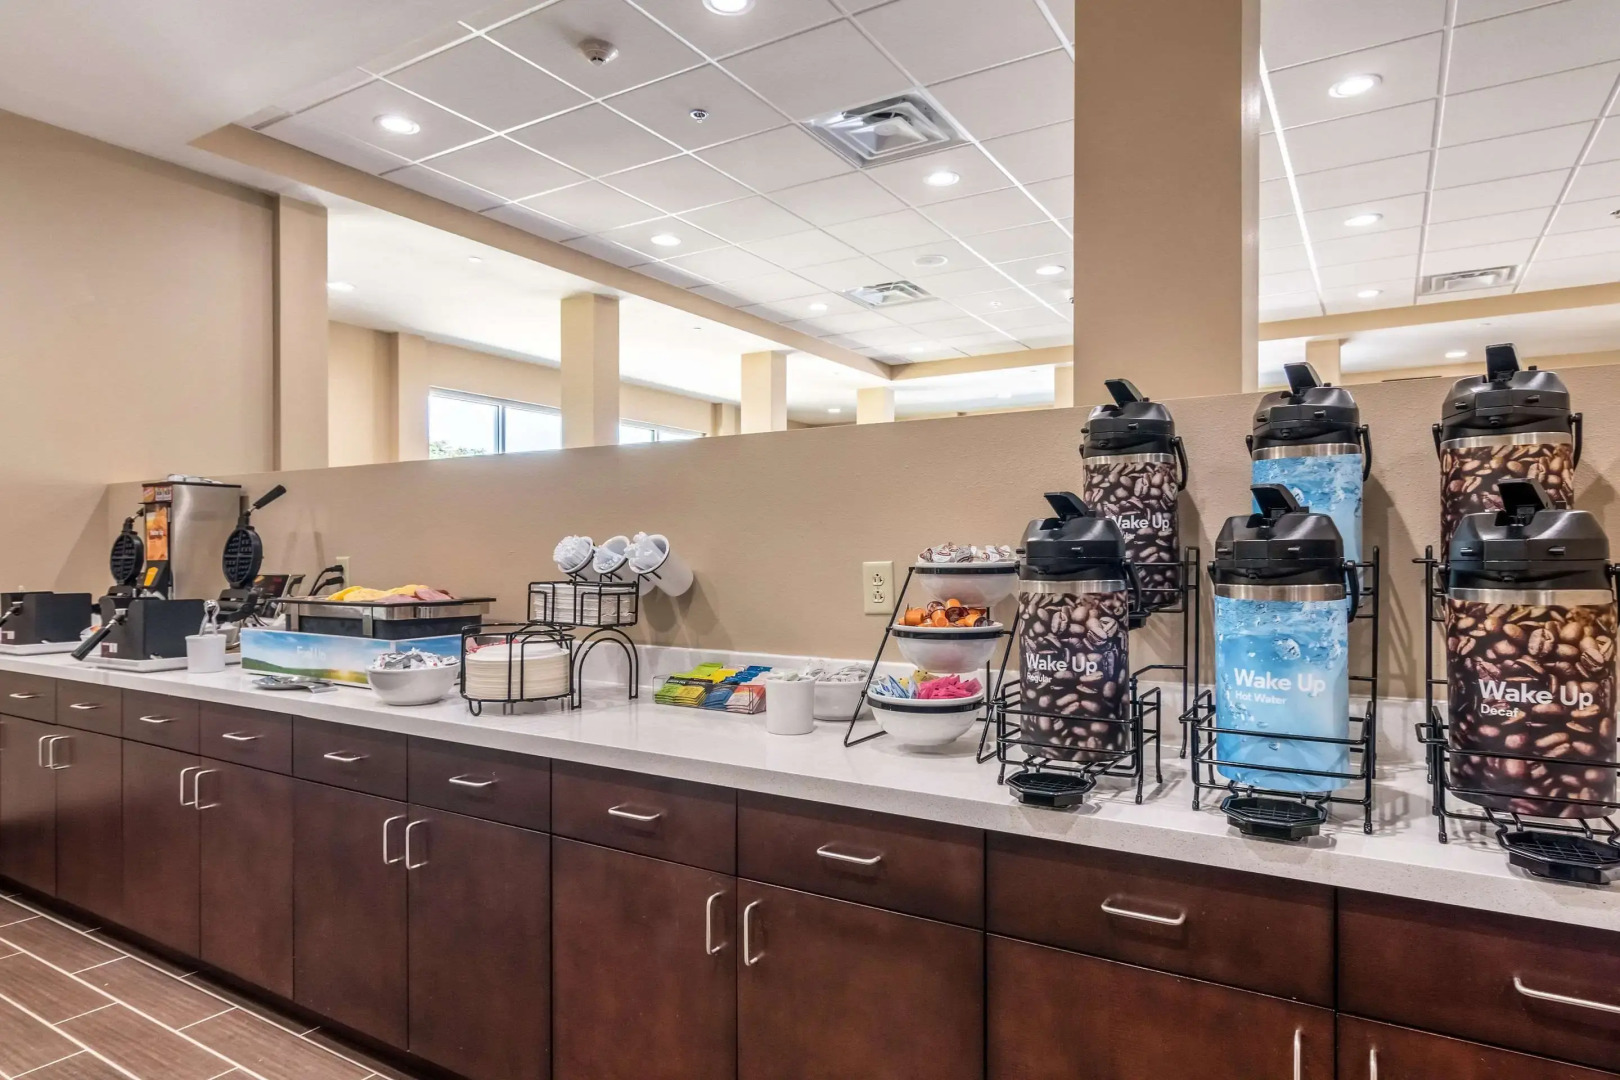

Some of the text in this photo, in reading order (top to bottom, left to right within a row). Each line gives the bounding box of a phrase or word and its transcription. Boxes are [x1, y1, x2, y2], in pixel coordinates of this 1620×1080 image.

[1152, 515, 1170, 532] Up
[1026, 653, 1098, 676] Wake Up
[1027, 673, 1053, 683] Regular
[1233, 668, 1326, 697] Wake Up
[1235, 690, 1287, 705] Hot Water
[1478, 679, 1594, 710] Wake Up
[1480, 703, 1520, 718] Decaf
